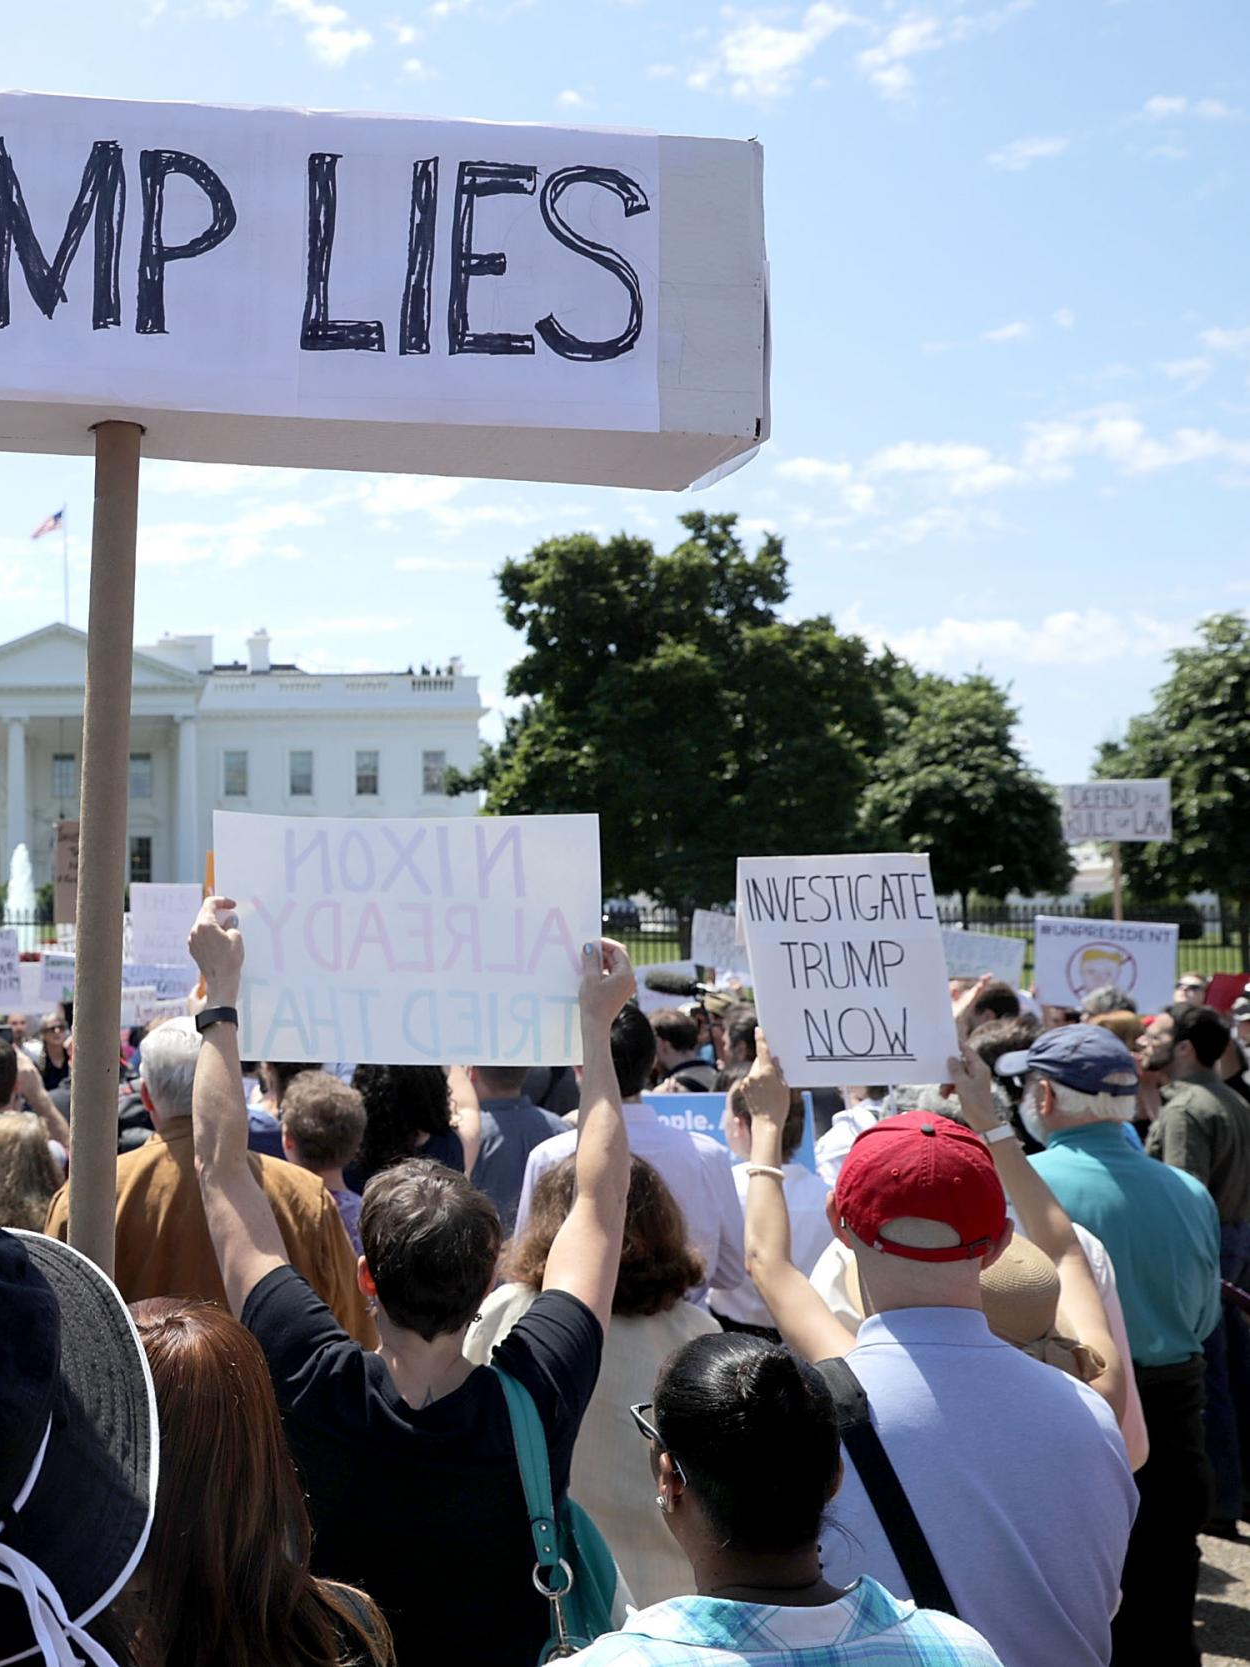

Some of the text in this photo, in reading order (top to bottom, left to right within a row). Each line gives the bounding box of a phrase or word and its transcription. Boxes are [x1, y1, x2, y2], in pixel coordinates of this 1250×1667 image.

[300, 152, 650, 362] LIES
[1070, 785, 1138, 810] DEFEND
[1067, 811, 1114, 837] RULE
[1133, 809, 1168, 835] LAW
[745, 873, 934, 923] INVESTIGATE
[1040, 923, 1172, 944] #UNPRESIDENT
[780, 940, 905, 990] TRUMP
[803, 1007, 908, 1057] NOW
